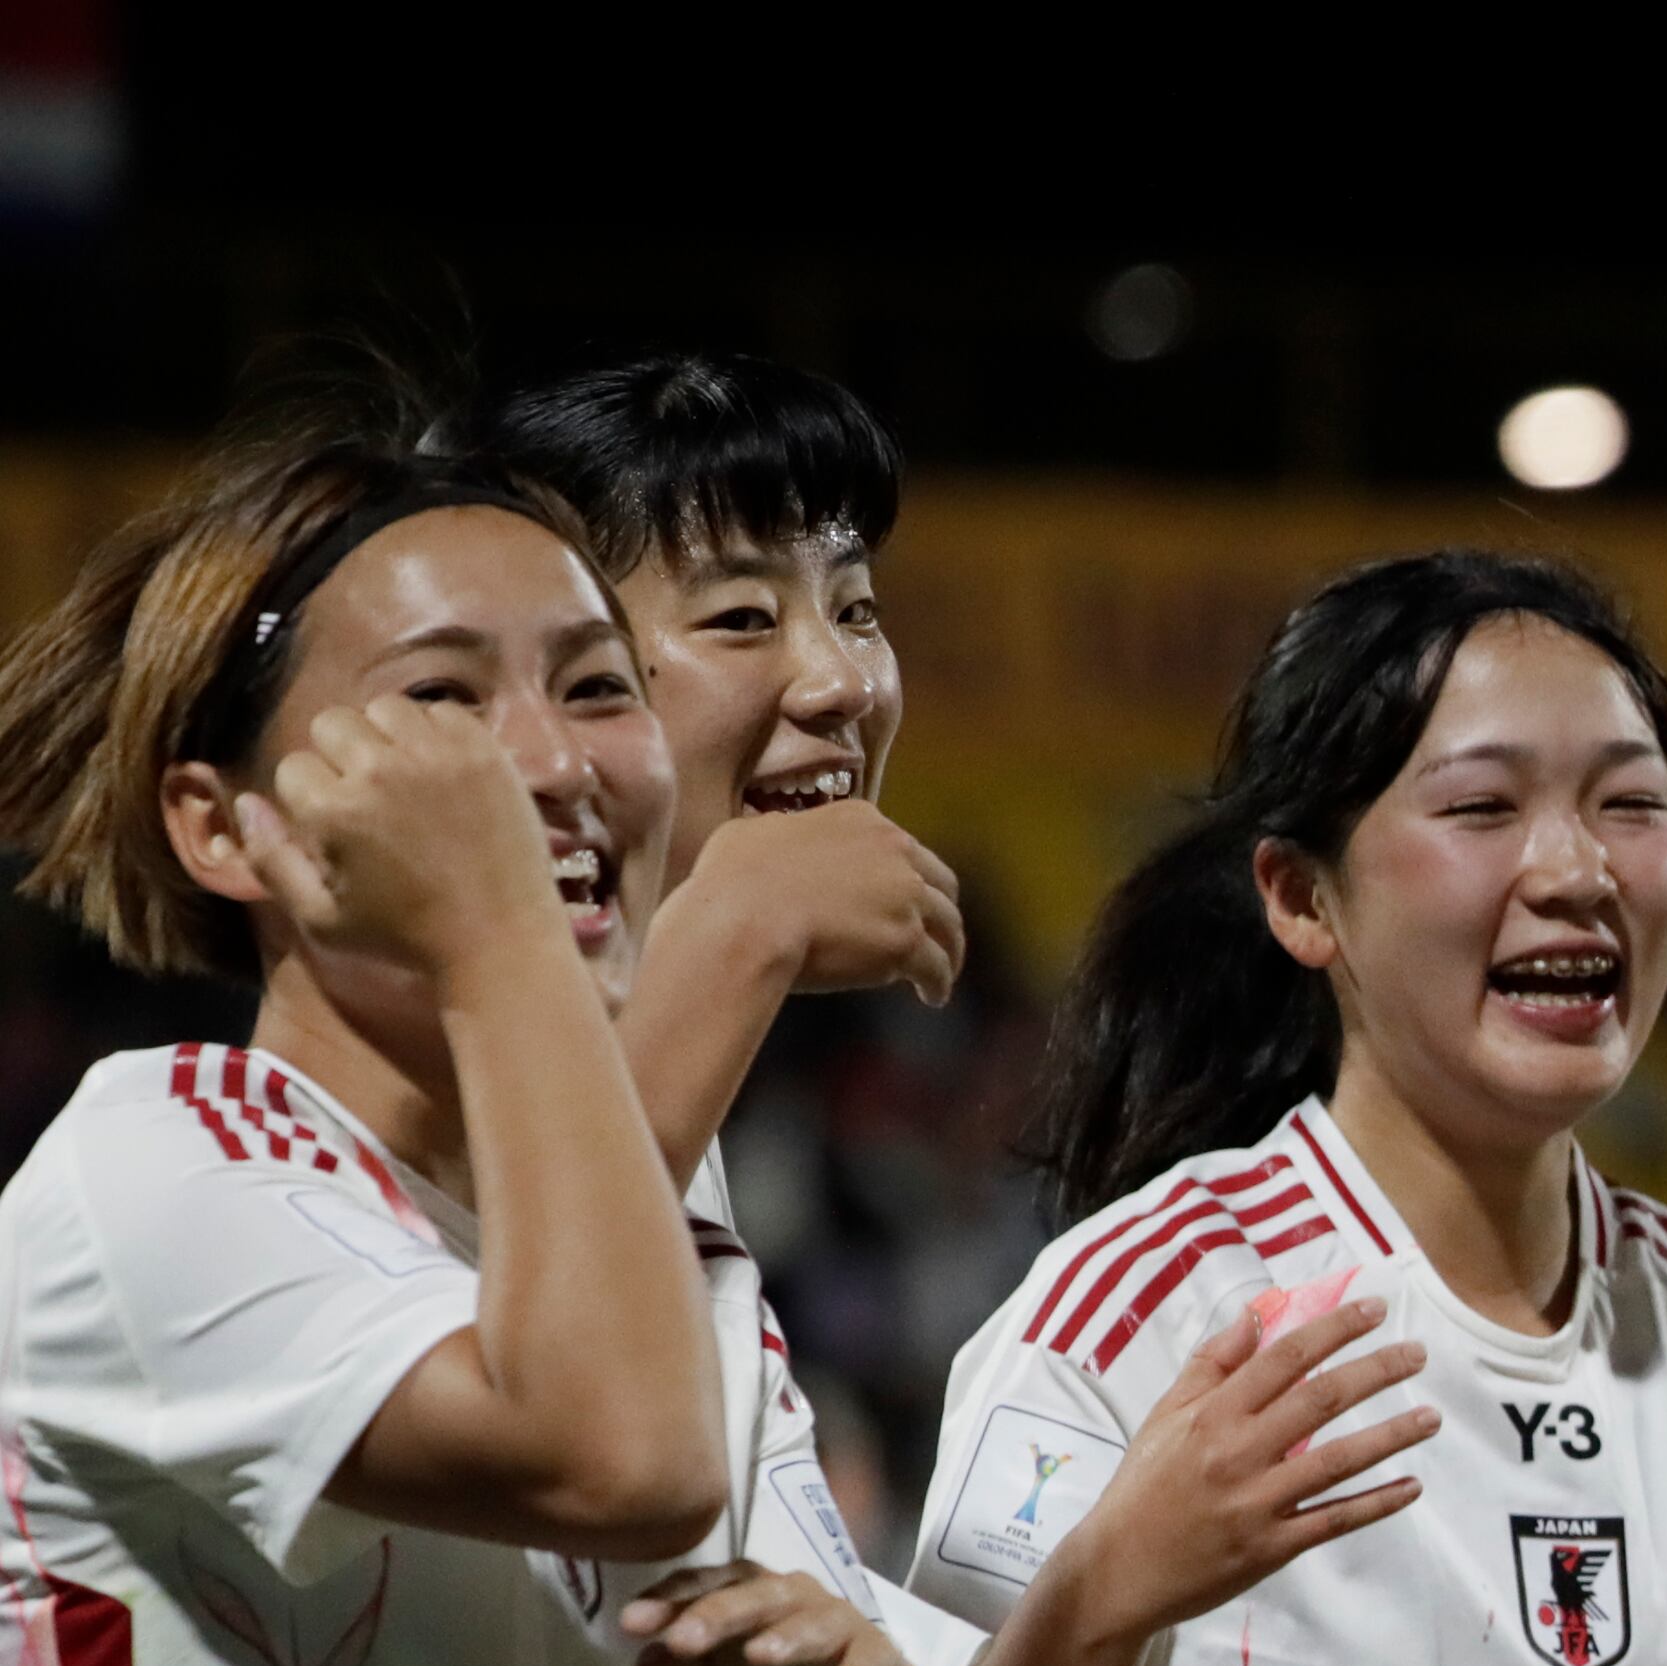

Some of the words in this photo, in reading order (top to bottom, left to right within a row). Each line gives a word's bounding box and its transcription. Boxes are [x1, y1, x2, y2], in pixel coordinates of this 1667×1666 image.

[1500, 1401, 1602, 1462] Y-3
[1534, 1518, 1598, 1536] JAPAN
[1553, 1631, 1601, 1657] JFA
